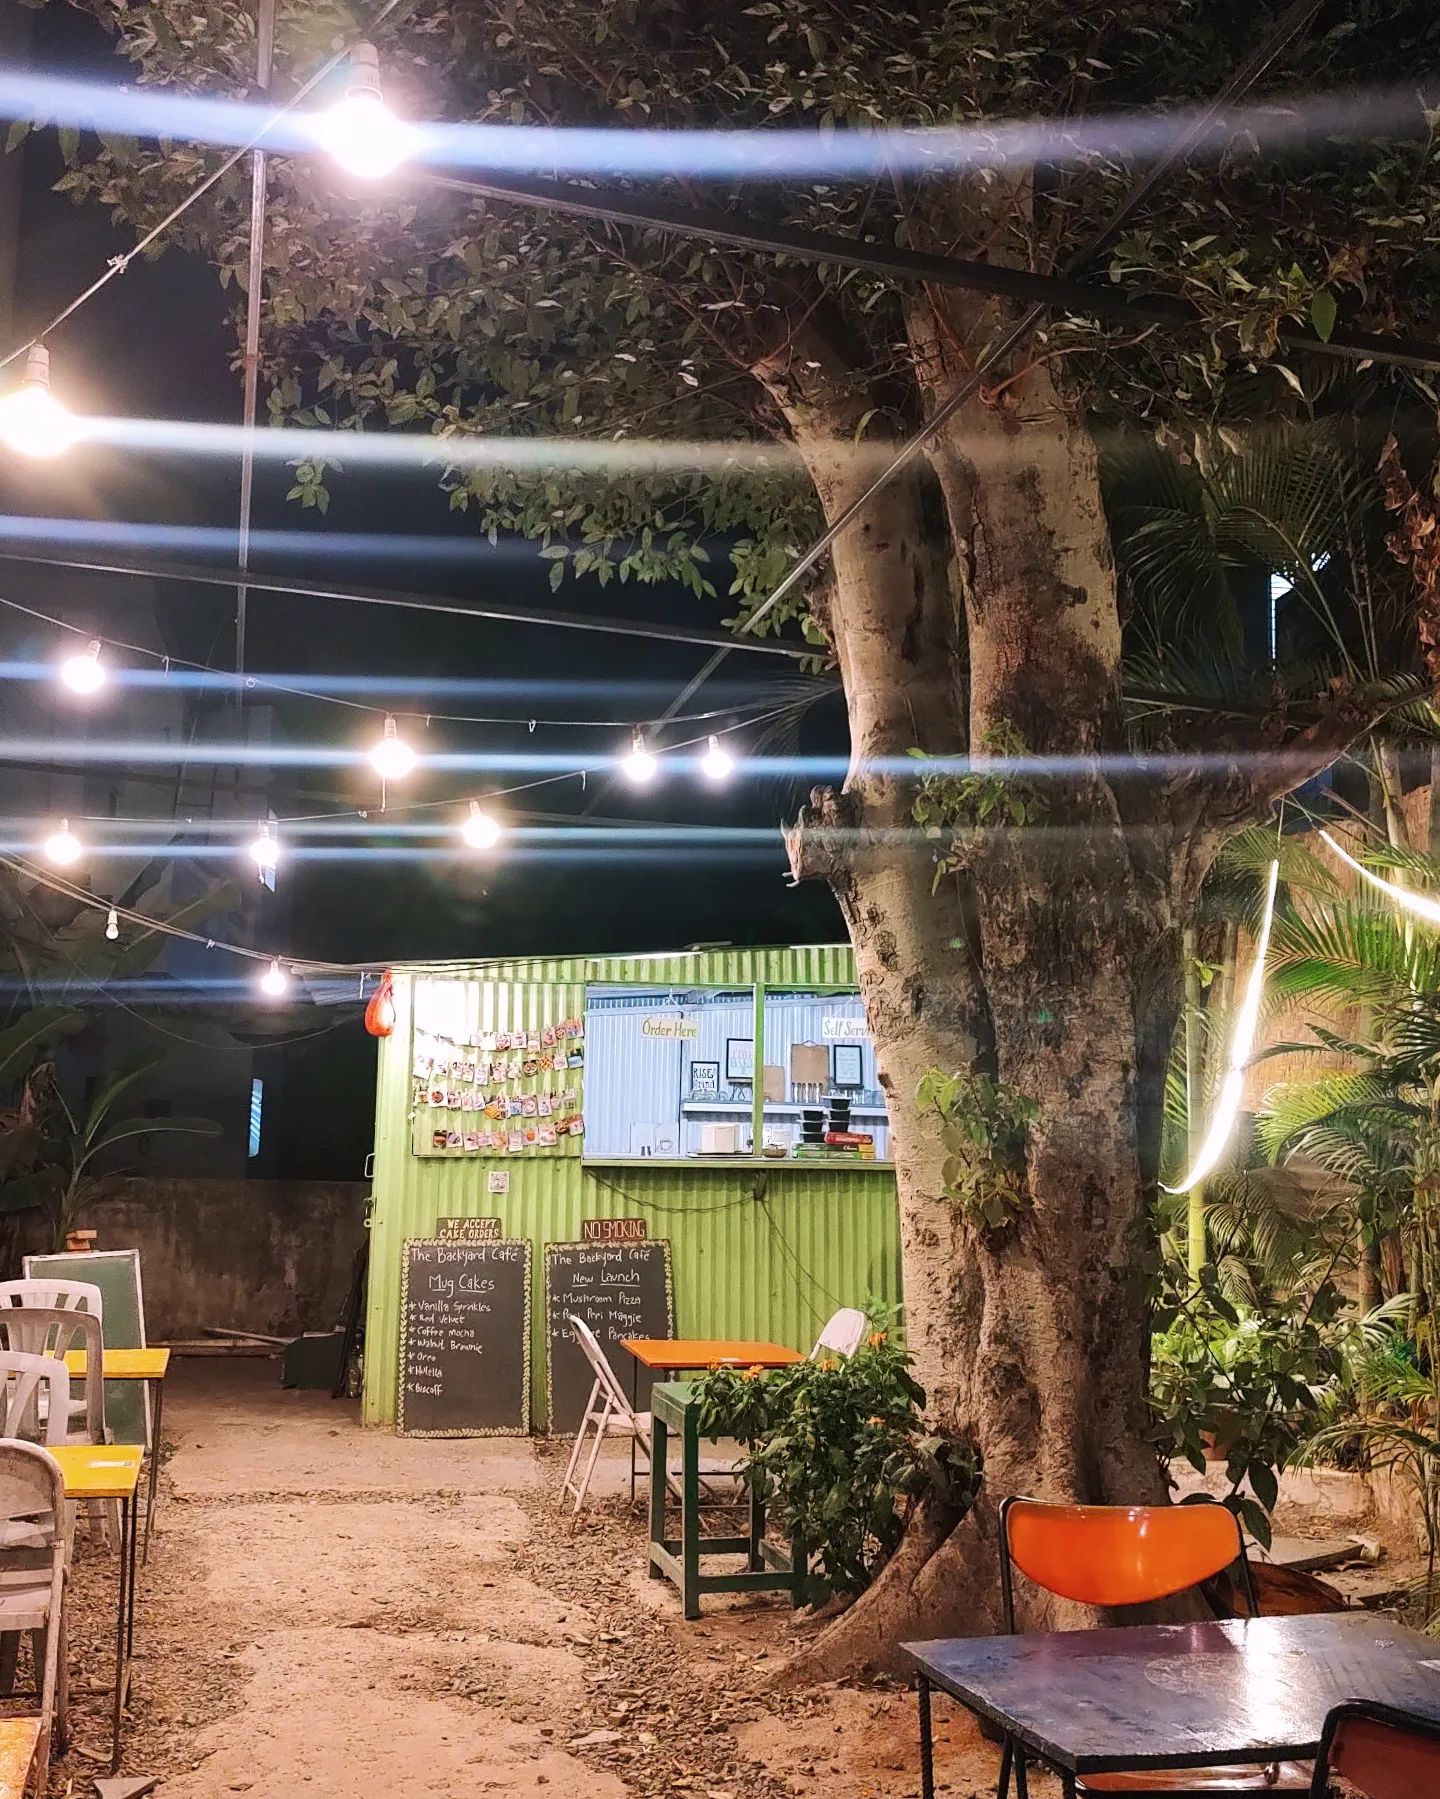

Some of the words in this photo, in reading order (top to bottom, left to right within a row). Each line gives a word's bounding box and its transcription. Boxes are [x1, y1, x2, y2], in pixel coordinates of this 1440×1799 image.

[642, 1020, 672, 1036] Order
[674, 1021, 697, 1037] Here
[824, 1019, 843, 1037] Self
[844, 1021, 869, 1036] Serv
[447, 1219, 459, 1229] WE
[463, 1219, 497, 1229] ACCEPT
[584, 1221, 600, 1239] NO
[603, 1220, 645, 1239] SMOKING
[440, 1229, 464, 1239] CAKE
[468, 1228, 500, 1239] ORDERS
[412, 1248, 432, 1262] The
[437, 1247, 486, 1267] Backyard
[491, 1247, 519, 1262] Café
[552, 1253, 572, 1265] The
[579, 1249, 622, 1267] Backyard
[629, 1248, 651, 1261] Café
[573, 1273, 594, 1283] New
[601, 1269, 640, 1283] Launch
[428, 1274, 454, 1299] Mug
[458, 1273, 495, 1291] Cakes
[562, 1292, 612, 1304] Mushroom
[618, 1292, 641, 1305] Pizza
[418, 1300, 449, 1313] Vanilla
[453, 1301, 491, 1313] Sprinkles
[419, 1313, 435, 1324] Red
[587, 1308, 604, 1320] Peri
[609, 1311, 642, 1328] Maggie
[417, 1326, 444, 1337] Coffee
[450, 1340, 483, 1354] Brownie
[417, 1352, 436, 1362] Oreo
